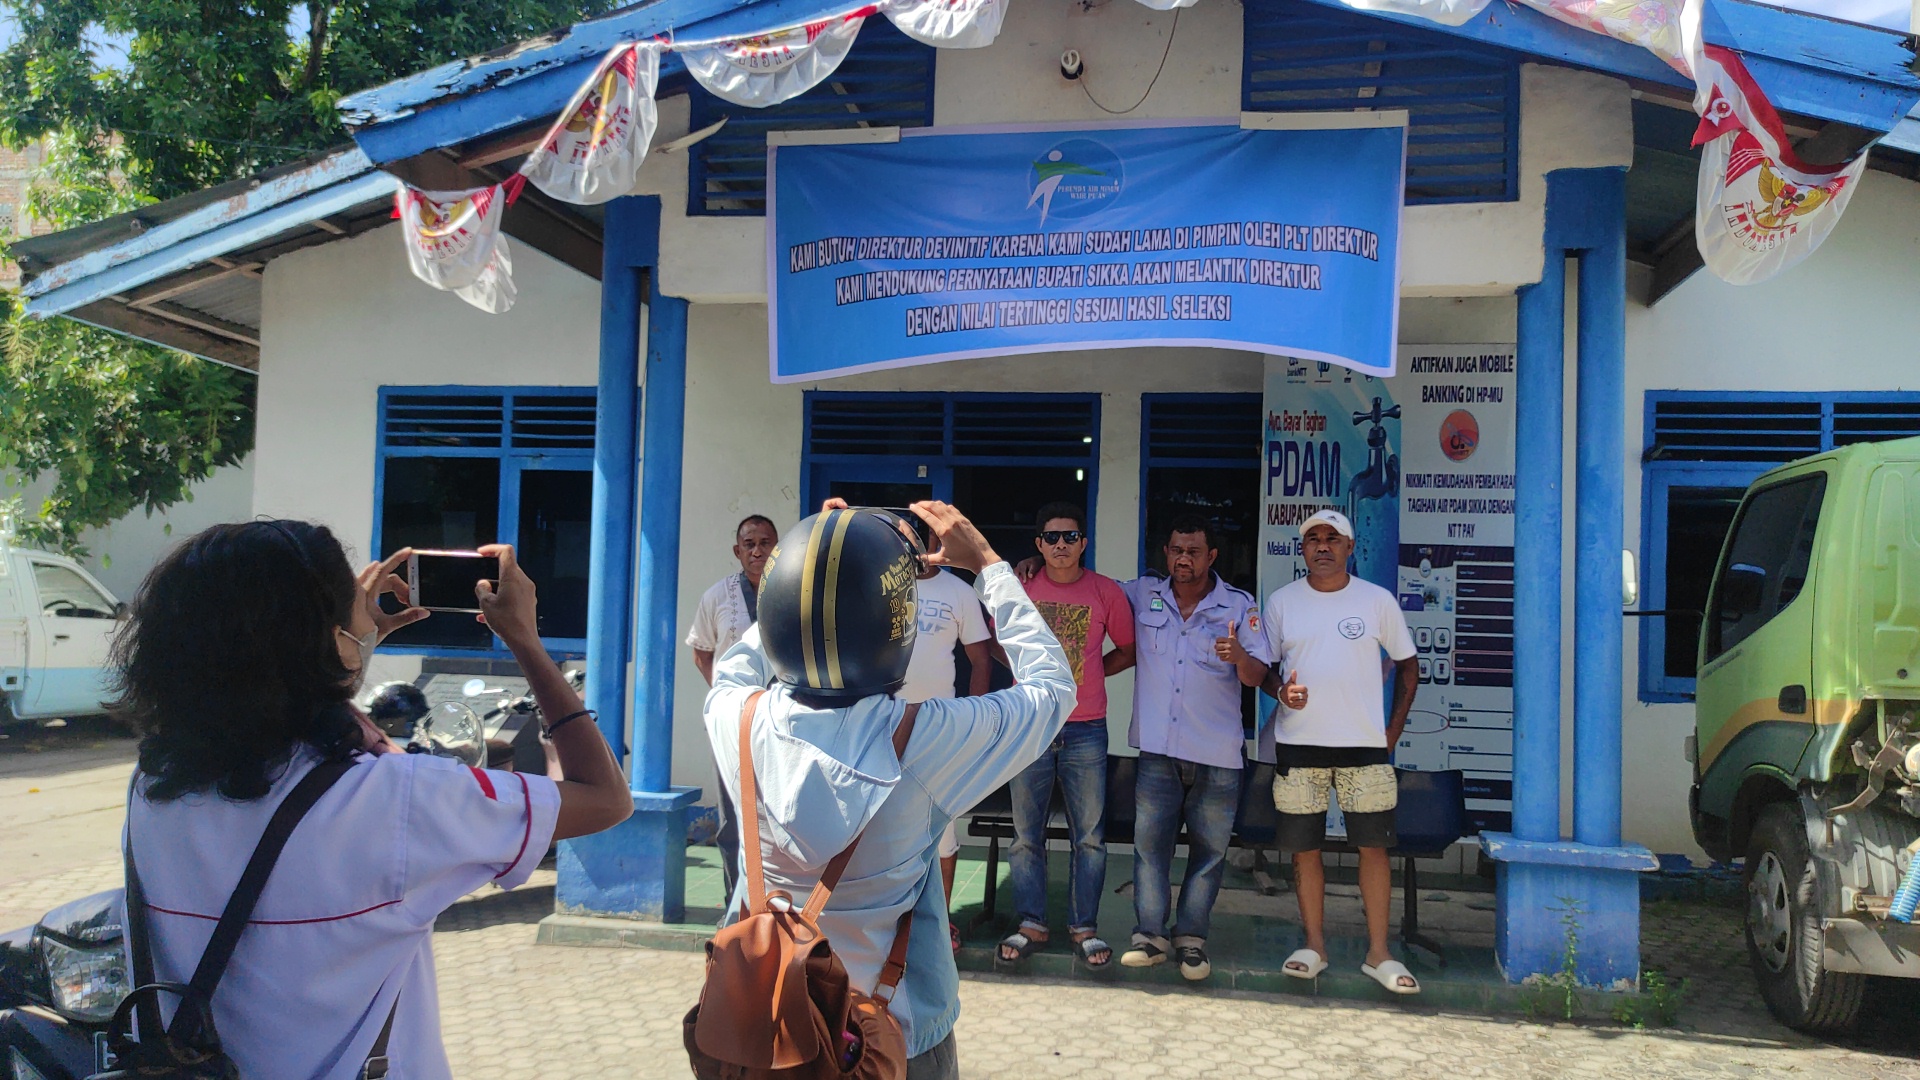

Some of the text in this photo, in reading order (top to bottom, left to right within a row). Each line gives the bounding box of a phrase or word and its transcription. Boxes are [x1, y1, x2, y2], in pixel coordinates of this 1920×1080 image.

[790, 221, 1379, 273] KAMI BUTUH DIREKTUR DEVINITIF KARENA KAMI SUDAH LAMA DI PIMPIN OLEH PLT DIREKTUR
[836, 258, 1321, 305] KAMI MENDUKUNG PERNYATAAN BUPATI SIKKA AKAN MELANTIK DIREKTUR
[906, 295, 1232, 337] DENGAN NILAI TERTINGGI SESUAI HASIL SELEKSI
[1411, 355, 1514, 374] AKTIFKAN JUGA MOBILE
[1421, 385, 1503, 403] BANKING DI HP-MU
[1283, 409, 1302, 436] Bayar
[1303, 409, 1327, 437] Tagihan
[1267, 441, 1341, 497] PDAM
[1405, 473, 1432, 488] NIKMATI
[1433, 473, 1474, 489] KEMUDAHAN
[1408, 498, 1436, 513] TAGIHAN
[1437, 499, 1448, 513] AIR
[1449, 499, 1468, 513] PDAM
[1468, 499, 1487, 513] SIKKA
[1463, 523, 1476, 538] PAY
[1267, 541, 1291, 556] Melalui
